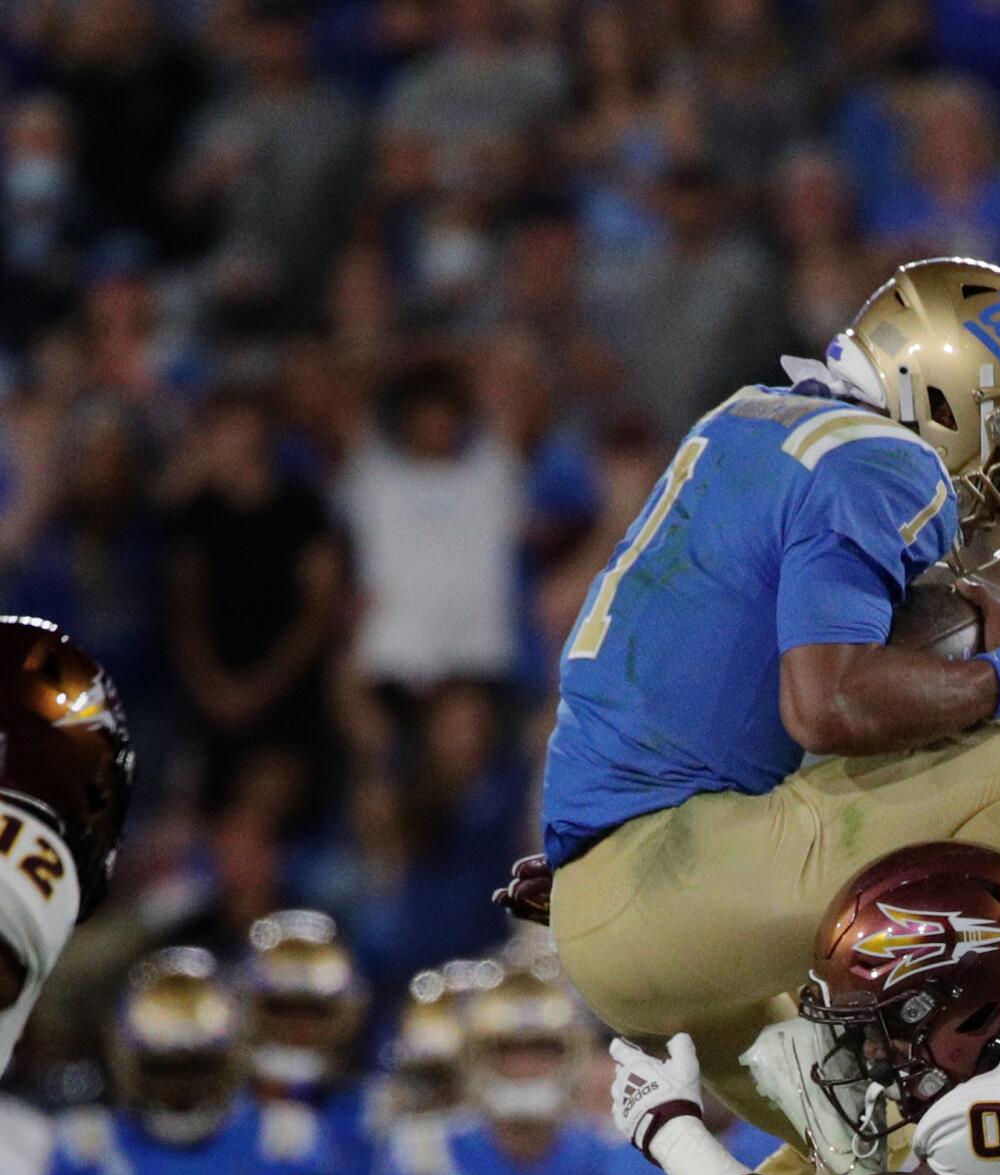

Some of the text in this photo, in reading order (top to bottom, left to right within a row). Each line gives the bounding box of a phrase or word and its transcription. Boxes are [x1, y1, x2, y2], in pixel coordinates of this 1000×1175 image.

[899, 480, 947, 546] 1
[0, 815, 64, 902] 12
[622, 1081, 660, 1119] adidas
